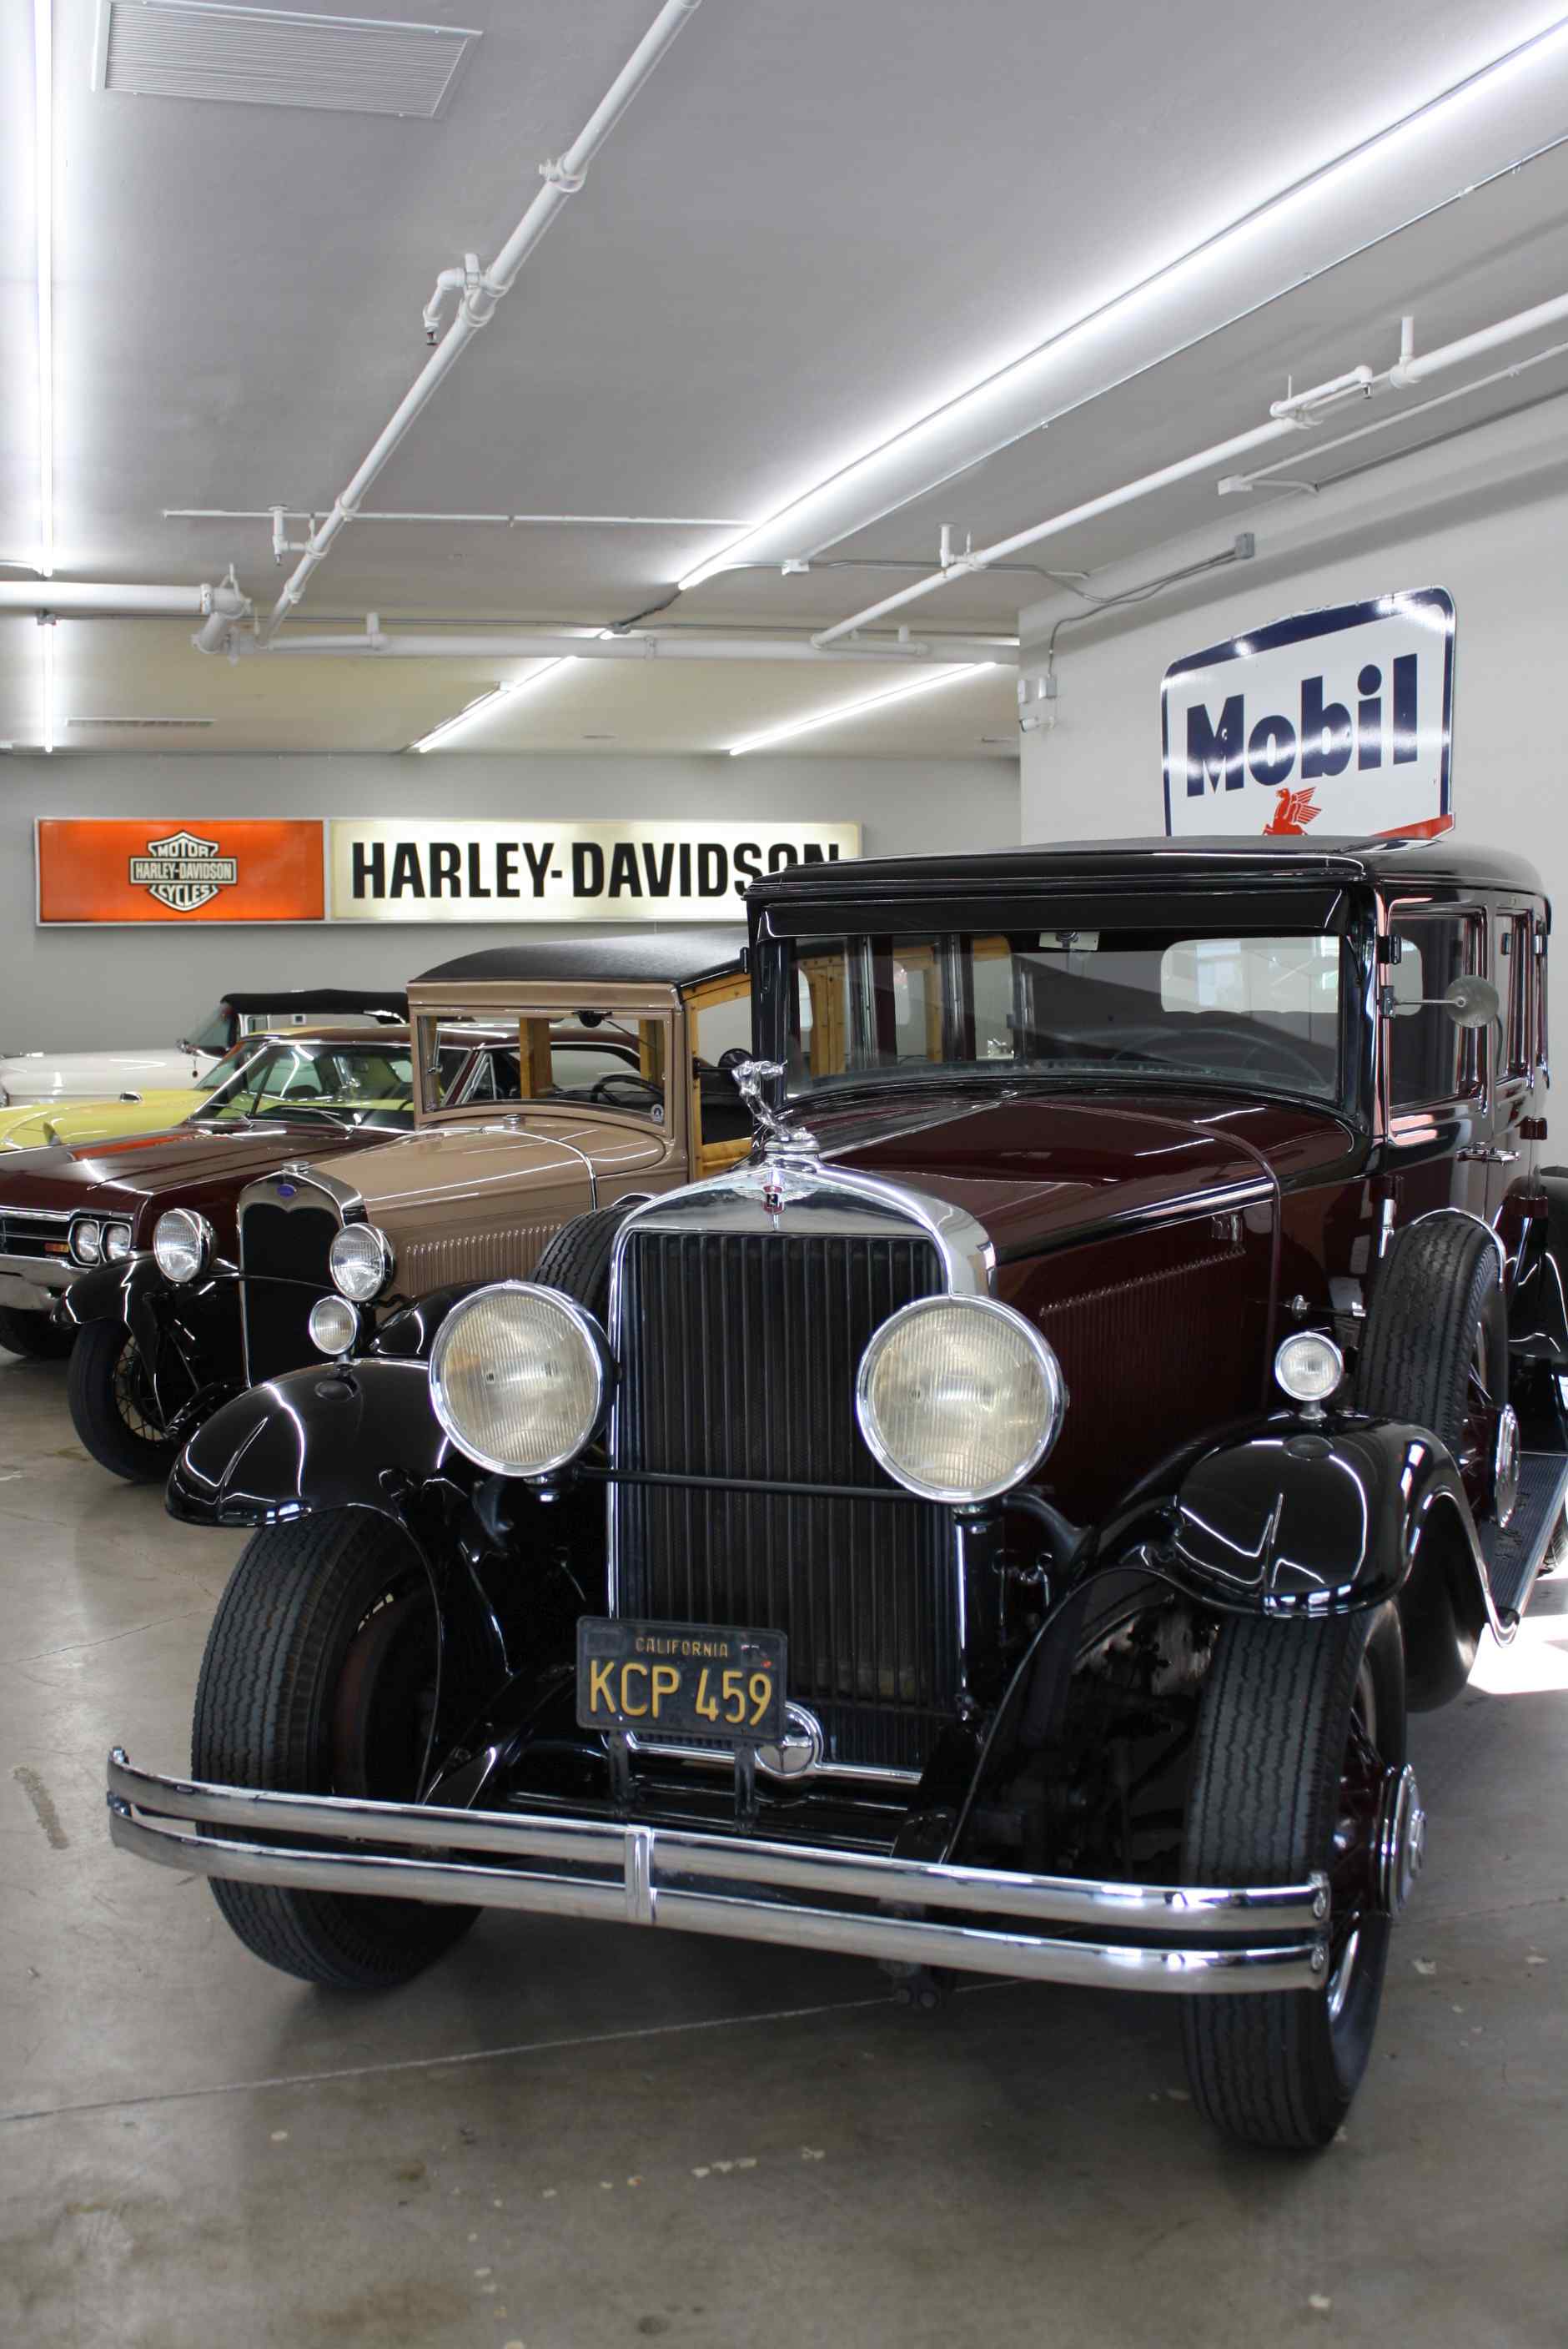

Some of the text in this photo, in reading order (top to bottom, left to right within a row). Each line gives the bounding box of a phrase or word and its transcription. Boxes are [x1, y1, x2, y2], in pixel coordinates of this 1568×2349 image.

[1187, 653, 1418, 797] Mobil
[157, 837, 209, 857] MOTOR
[134, 863, 232, 879] HARLEY-DAVIDSON
[158, 884, 210, 907] CYCLES
[635, 1637, 728, 1657] CALIFORNIA
[590, 1659, 772, 1727] KCP 459
